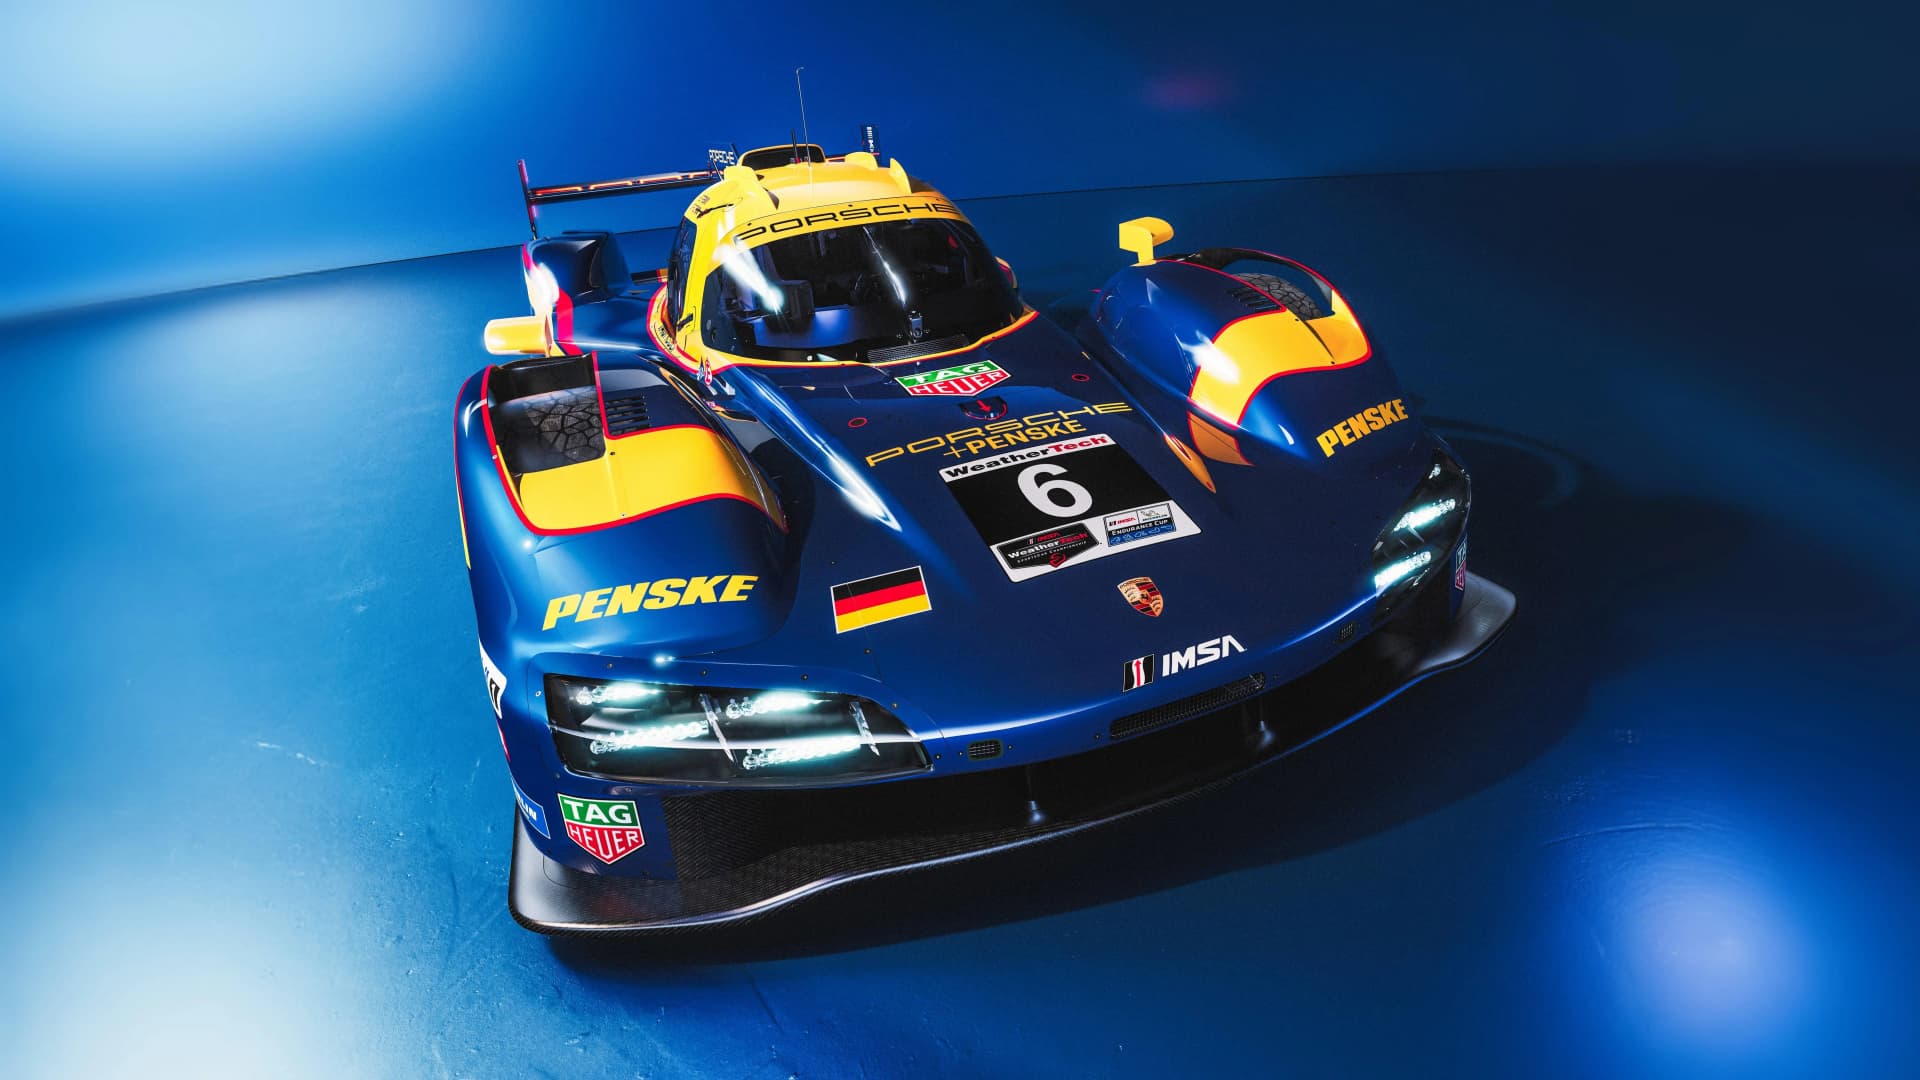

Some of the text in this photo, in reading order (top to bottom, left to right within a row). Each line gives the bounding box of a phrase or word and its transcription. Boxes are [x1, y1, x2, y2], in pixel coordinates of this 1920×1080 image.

[735, 202, 961, 241] PORSCHE
[904, 363, 990, 384] TAG
[911, 371, 1003, 394] HEUER
[864, 402, 1133, 468] PORSCHE
[1316, 398, 1409, 458] PENSKE
[945, 436, 1108, 478] WeatherTech
[1017, 463, 1093, 518] 6
[1007, 532, 1089, 559] WeatherTech
[541, 574, 759, 632] PENSKE
[1161, 634, 1248, 678] IMSA
[563, 799, 633, 824] TAG
[568, 824, 640, 860] HEUER
